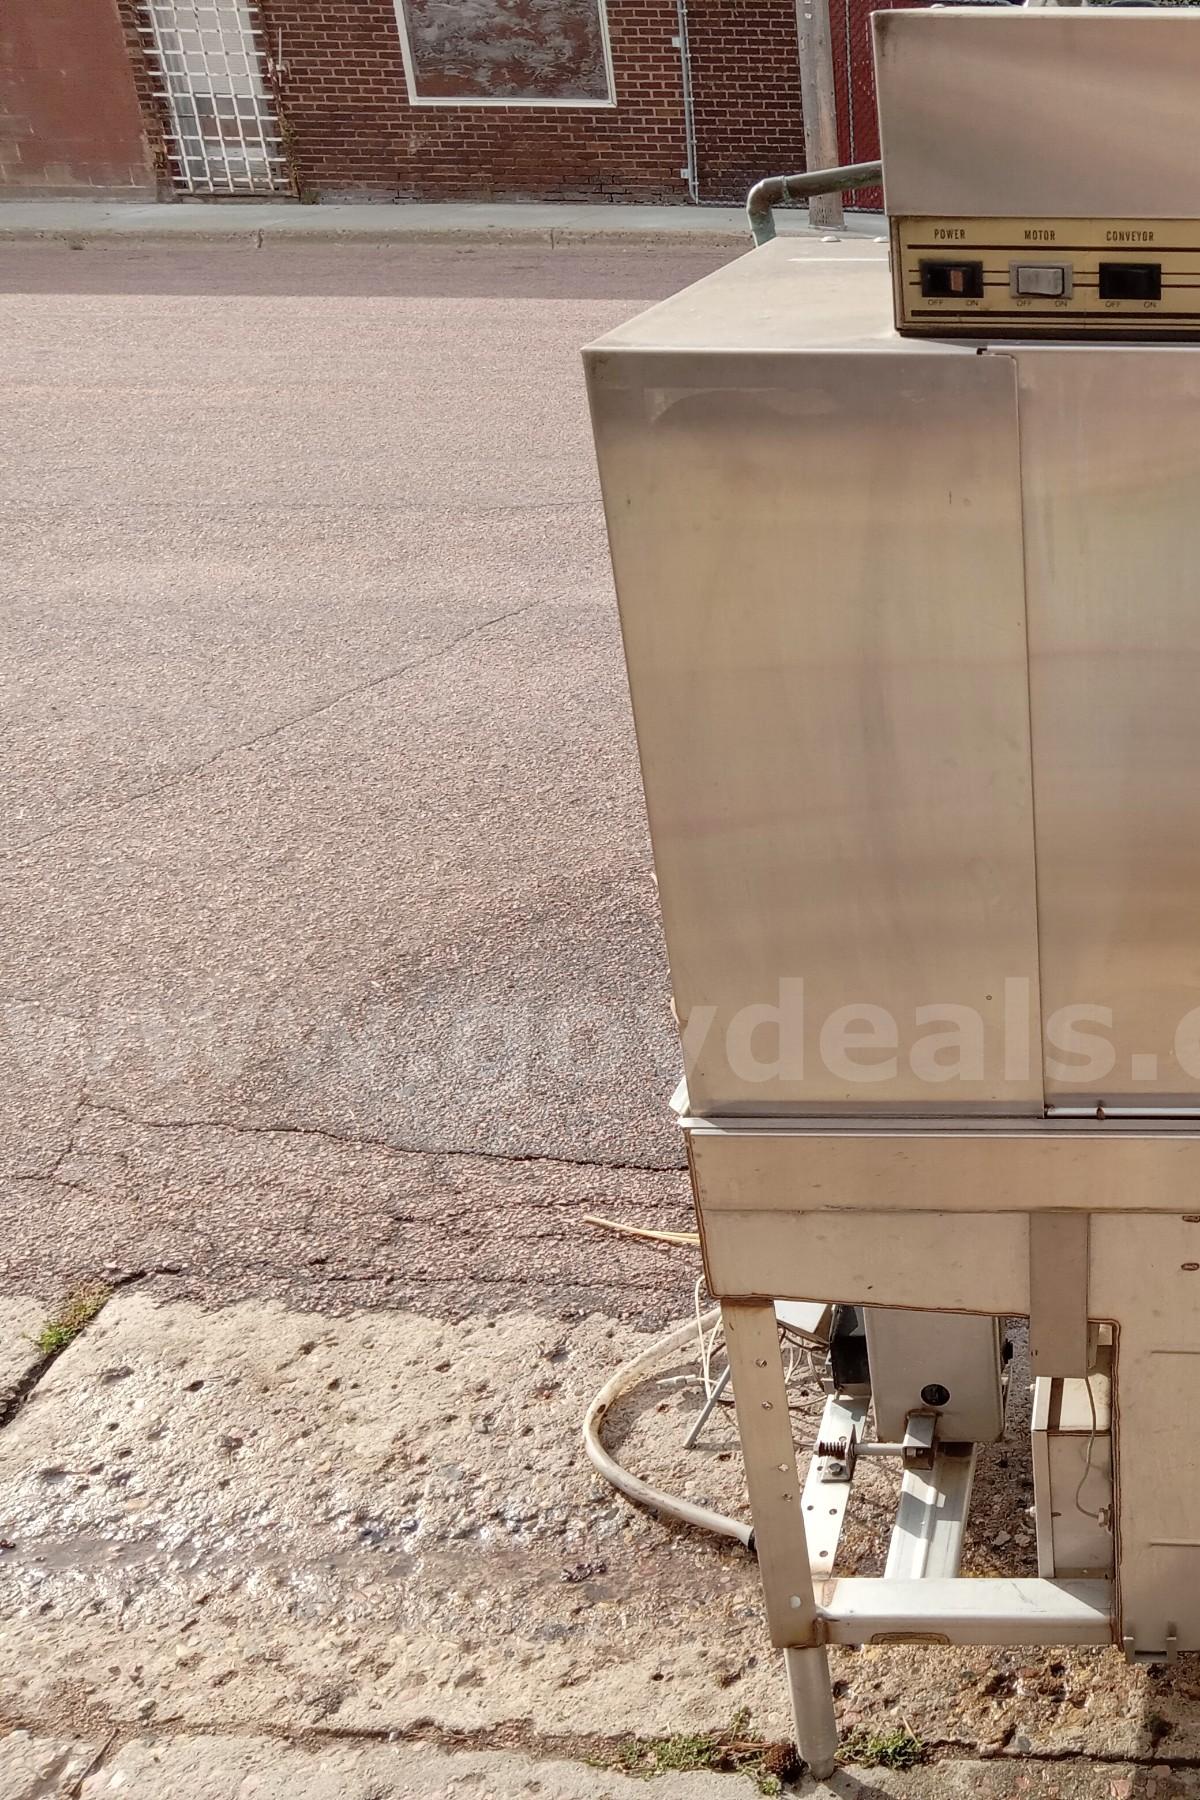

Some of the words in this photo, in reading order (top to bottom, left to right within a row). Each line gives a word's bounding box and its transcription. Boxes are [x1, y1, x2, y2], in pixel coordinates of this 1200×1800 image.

[934, 229, 966, 240] POWER
[1024, 230, 1056, 241] MOTOR
[1106, 231, 1155, 242] CONVEYOR
[966, 299, 979, 307] ON
[1016, 299, 1032, 307] OFF
[1054, 300, 1068, 308] ON
[1105, 300, 1121, 308] OFF
[1143, 301, 1157, 309] ON
